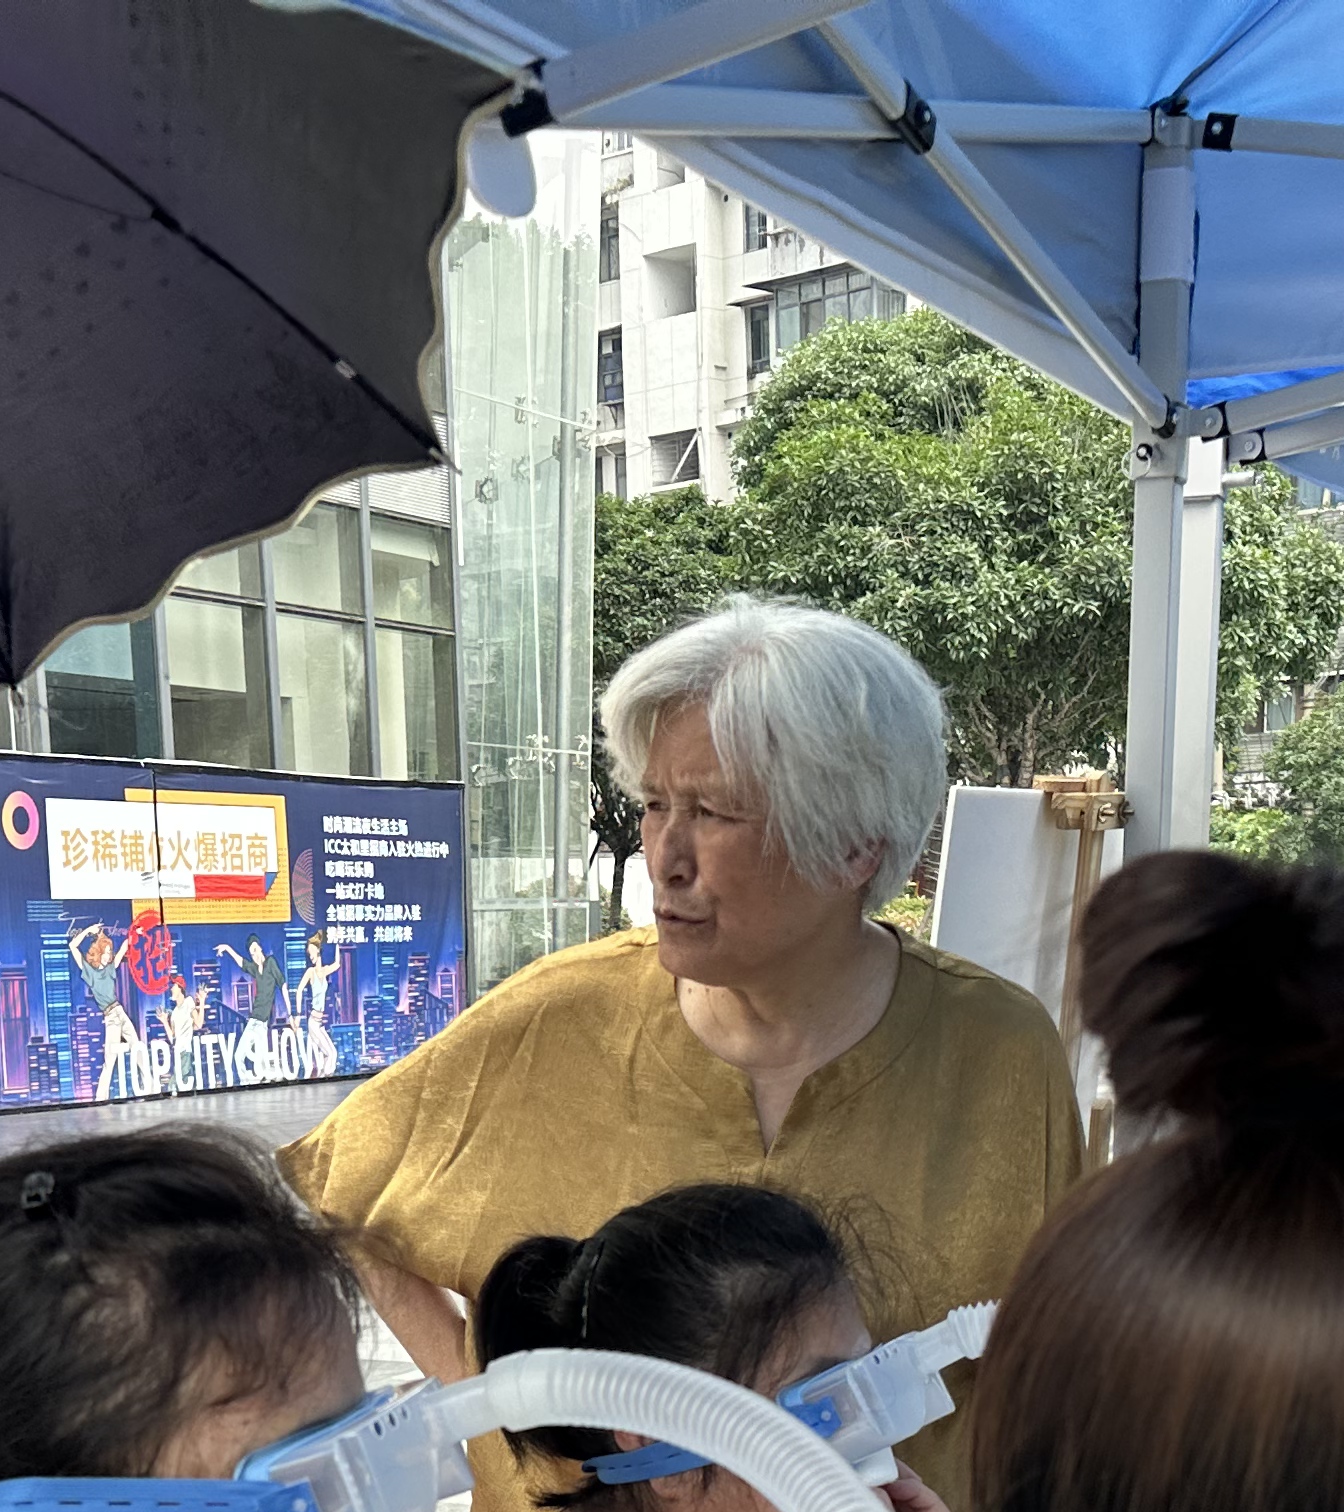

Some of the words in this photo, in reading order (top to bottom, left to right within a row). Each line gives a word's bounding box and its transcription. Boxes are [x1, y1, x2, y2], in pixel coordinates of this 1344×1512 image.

[60, 827, 269, 872] 珍稀铺位火爆招商
[111, 1040, 171, 1099] TOP
[174, 1033, 236, 1092] CITY
